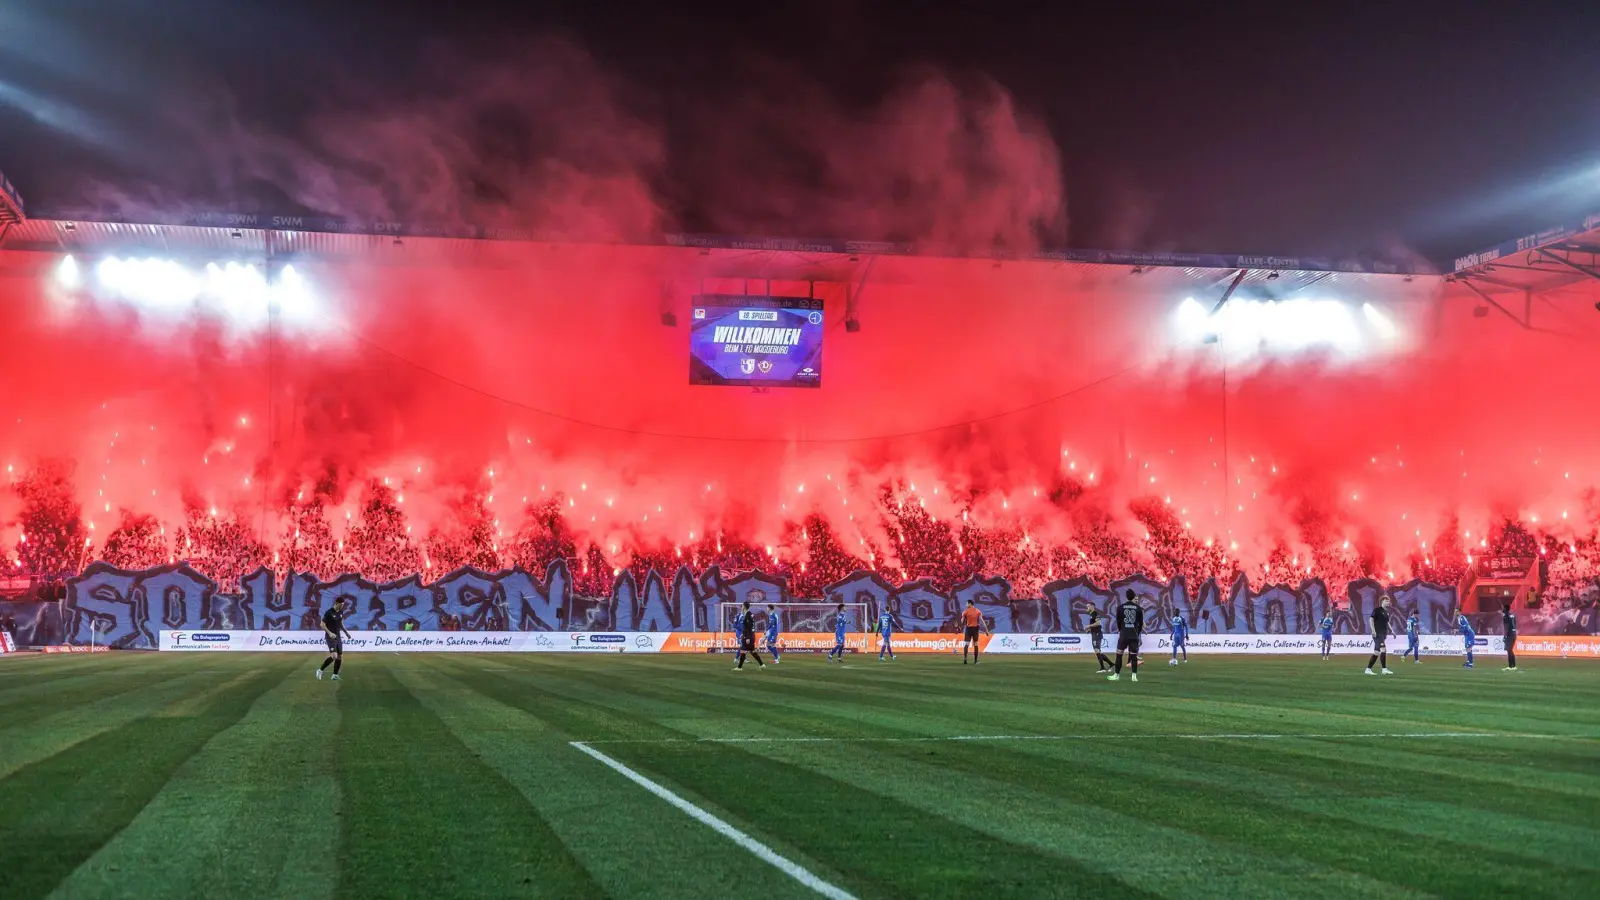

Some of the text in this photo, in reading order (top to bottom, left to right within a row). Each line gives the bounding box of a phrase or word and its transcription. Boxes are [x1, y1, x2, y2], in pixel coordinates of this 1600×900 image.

[227, 214, 258, 224] SWM
[272, 216, 303, 227] SWM
[713, 326, 801, 346] WILLKOMMEN
[724, 344, 739, 353] BEIM
[745, 346, 753, 354] FC
[753, 346, 789, 355] MAGDEBURG
[259, 636, 273, 647] Die
[375, 636, 393, 647] Dein
[395, 637, 433, 647] Callcenter
[446, 636, 512, 646] Sachsen-Anhalt!
[679, 636, 694, 648] Wir
[1158, 638, 1169, 648] Die
[1223, 639, 1249, 650] Factory
[1256, 639, 1271, 649] Dein
[1273, 640, 1305, 649] Callcenter
